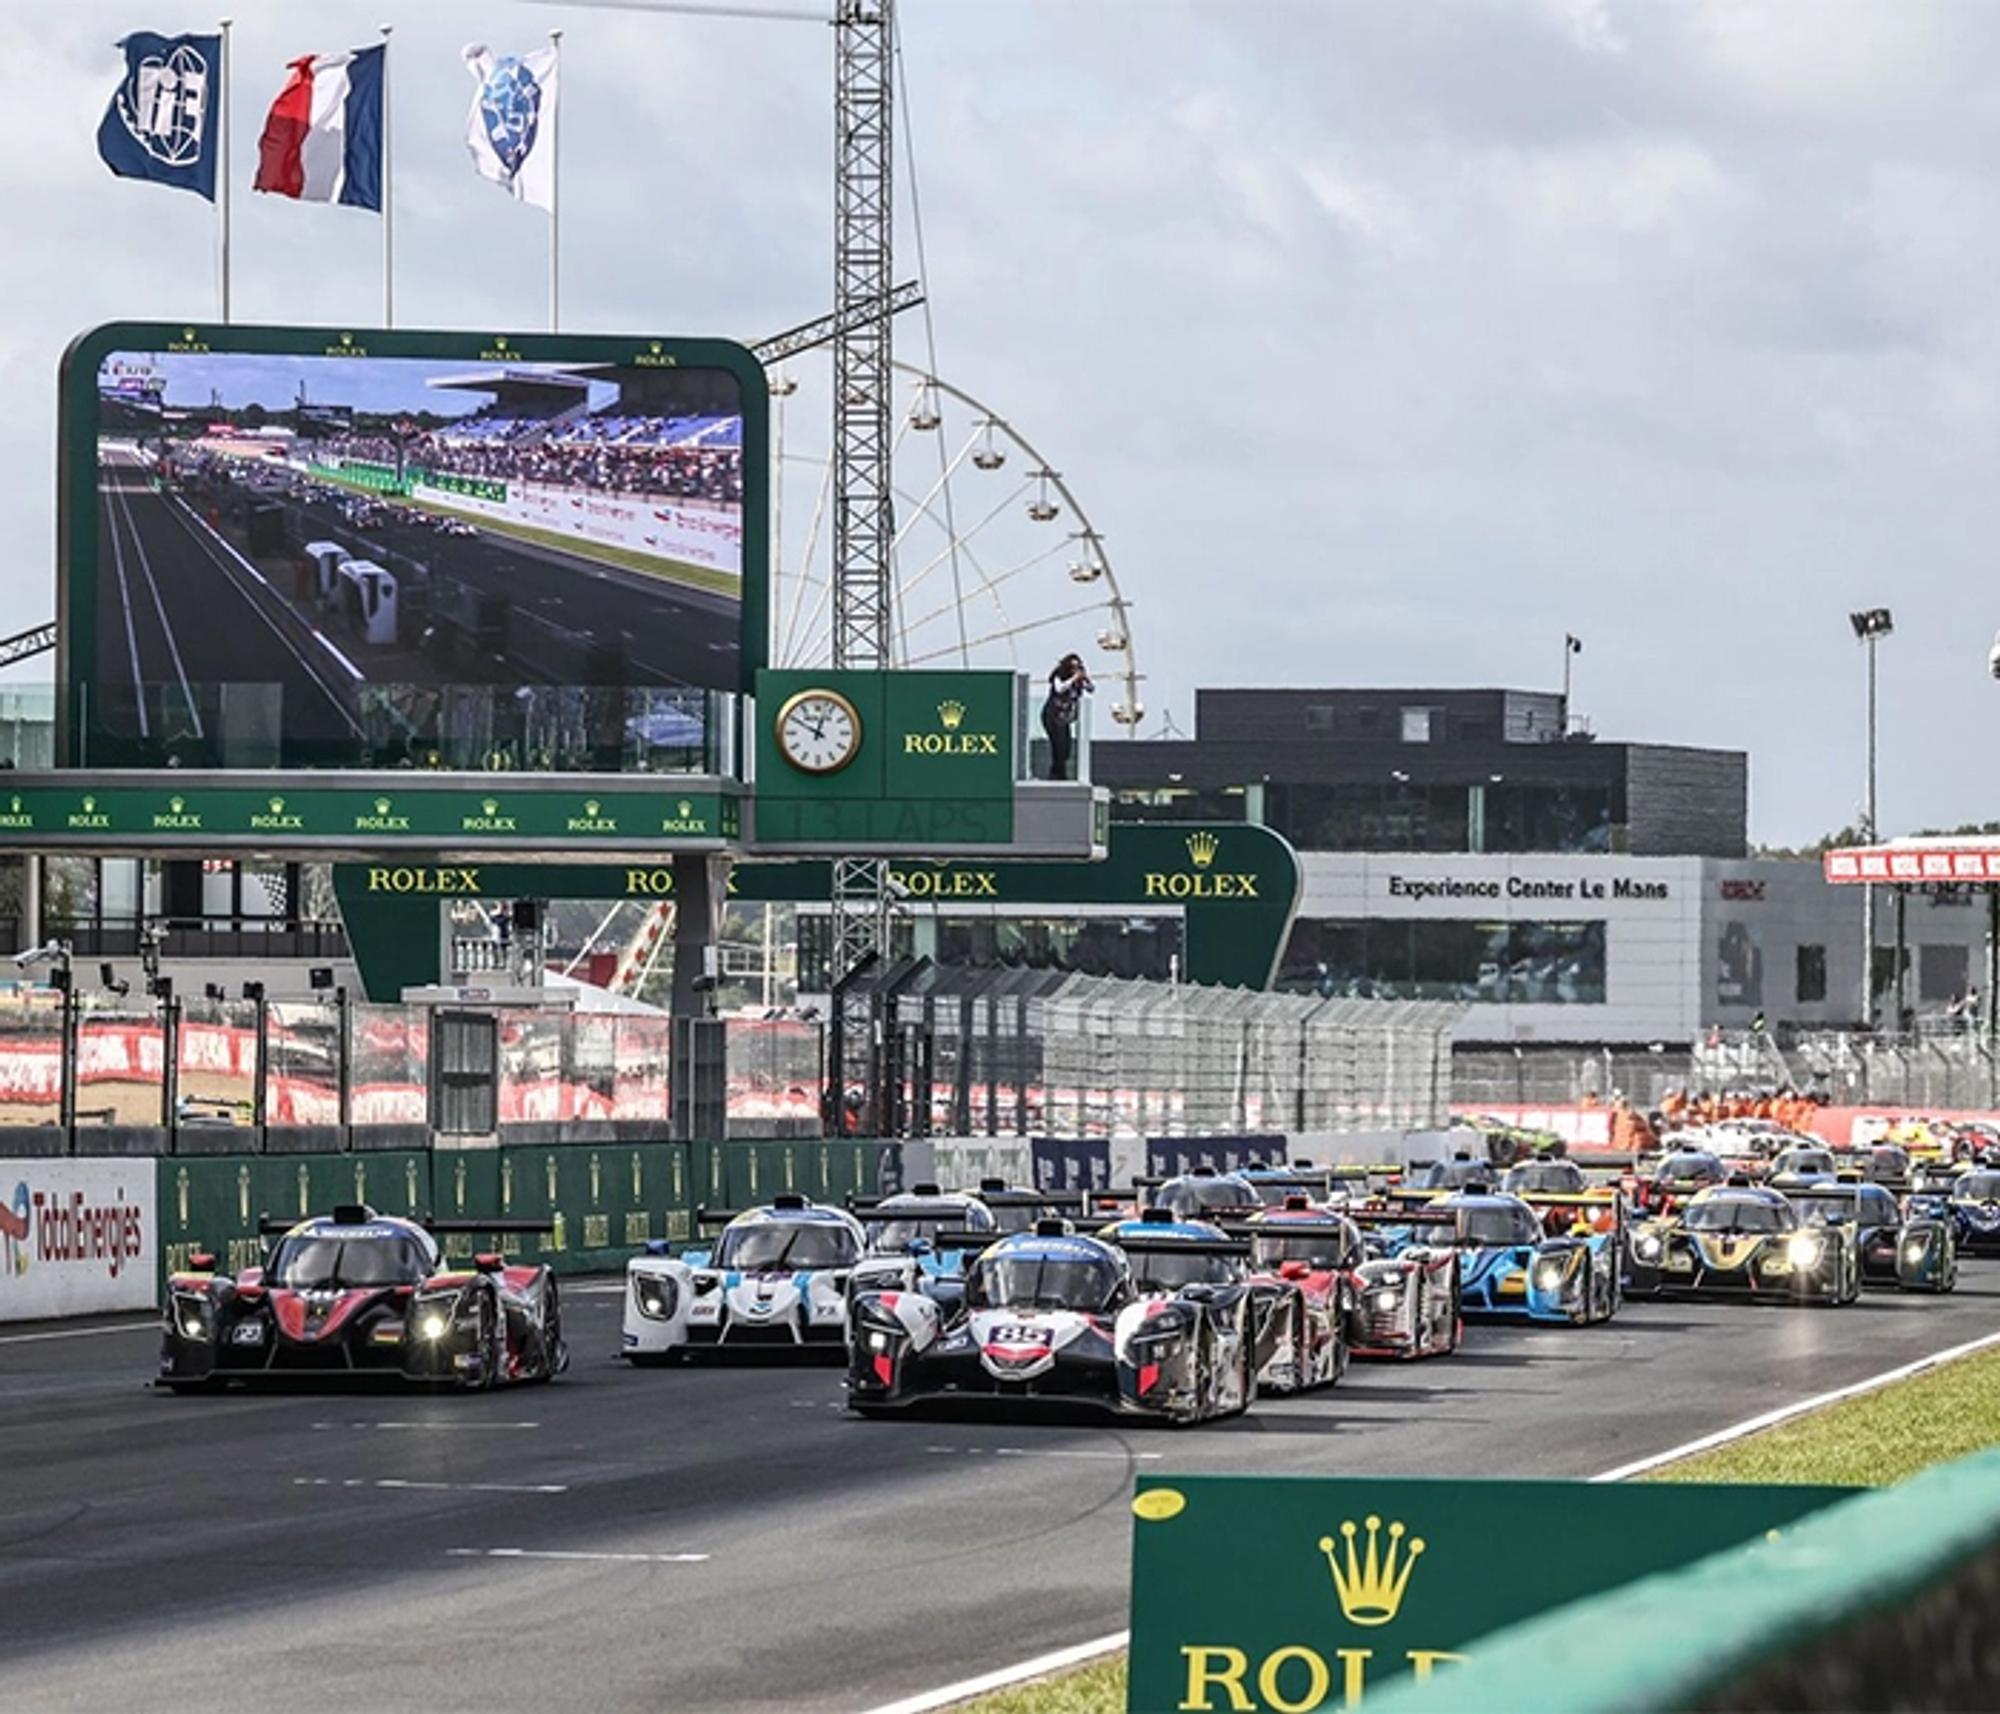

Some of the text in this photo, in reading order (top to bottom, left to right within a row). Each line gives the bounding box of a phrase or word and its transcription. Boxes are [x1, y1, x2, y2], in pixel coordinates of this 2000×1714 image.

[635, 356, 676, 366] ROLEX
[904, 734, 999, 754] ROLEX
[68, 815, 109, 827] ROLEX
[153, 815, 201, 827] ROLEX
[251, 816, 303, 828] ROLEX
[356, 817, 410, 829] ROLEX
[463, 818, 516, 830] ROLEX
[568, 818, 616, 831] ROLEX
[662, 819, 705, 832] ROLEX
[369, 869, 480, 891] ROLEX
[626, 869, 738, 893] ROX
[1145, 873, 1259, 897] ROLEX
[1389, 876, 1669, 900] Experience Center Le Mans
[33, 1187, 142, 1278] TotalEnergies
[999, 1327, 1043, 1343] 85
[1178, 1646, 1473, 1714] ROL
